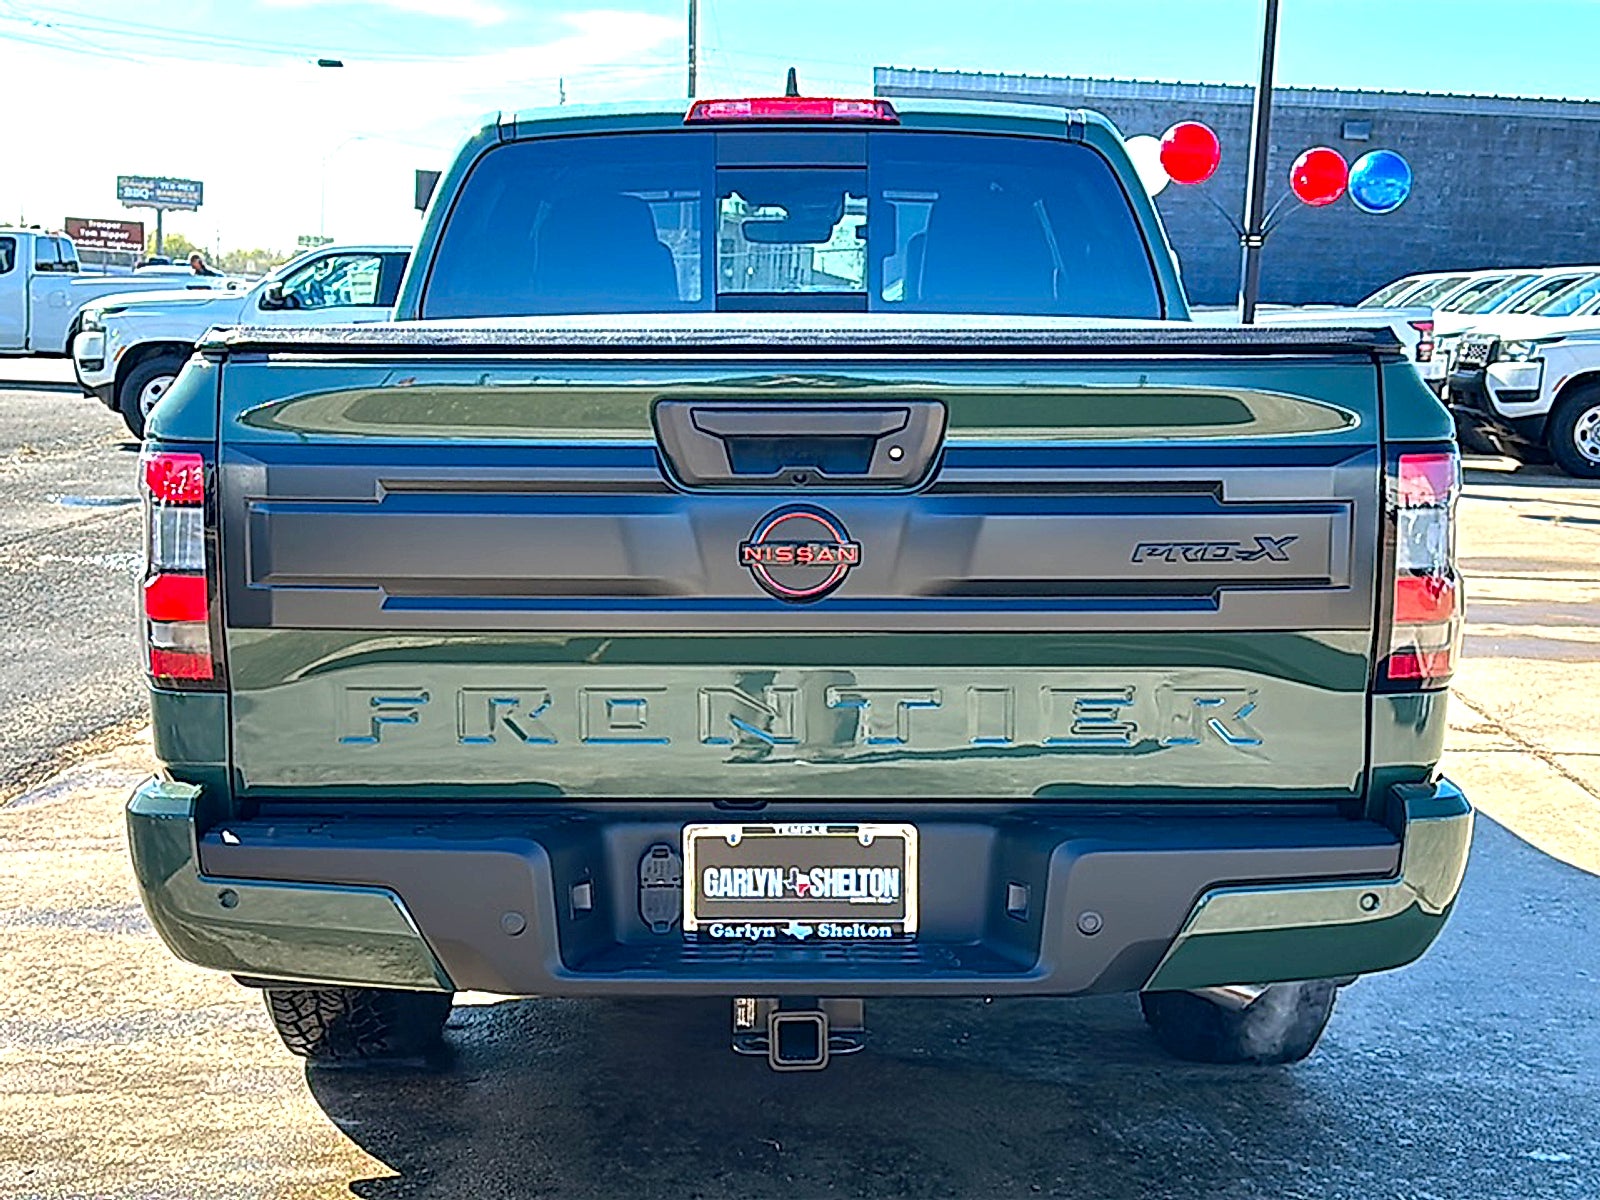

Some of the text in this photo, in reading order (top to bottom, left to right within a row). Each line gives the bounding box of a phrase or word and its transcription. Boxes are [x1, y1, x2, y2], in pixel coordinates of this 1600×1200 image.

[743, 546, 858, 562] NISSAN
[1130, 535, 1298, 563] PRO-X
[337, 686, 1265, 745] FRONTIER
[773, 825, 827, 835] TEMPLE
[703, 867, 783, 898] GARLYN
[809, 867, 900, 898] SHELTON
[708, 922, 893, 942] Garlyn Shelton
